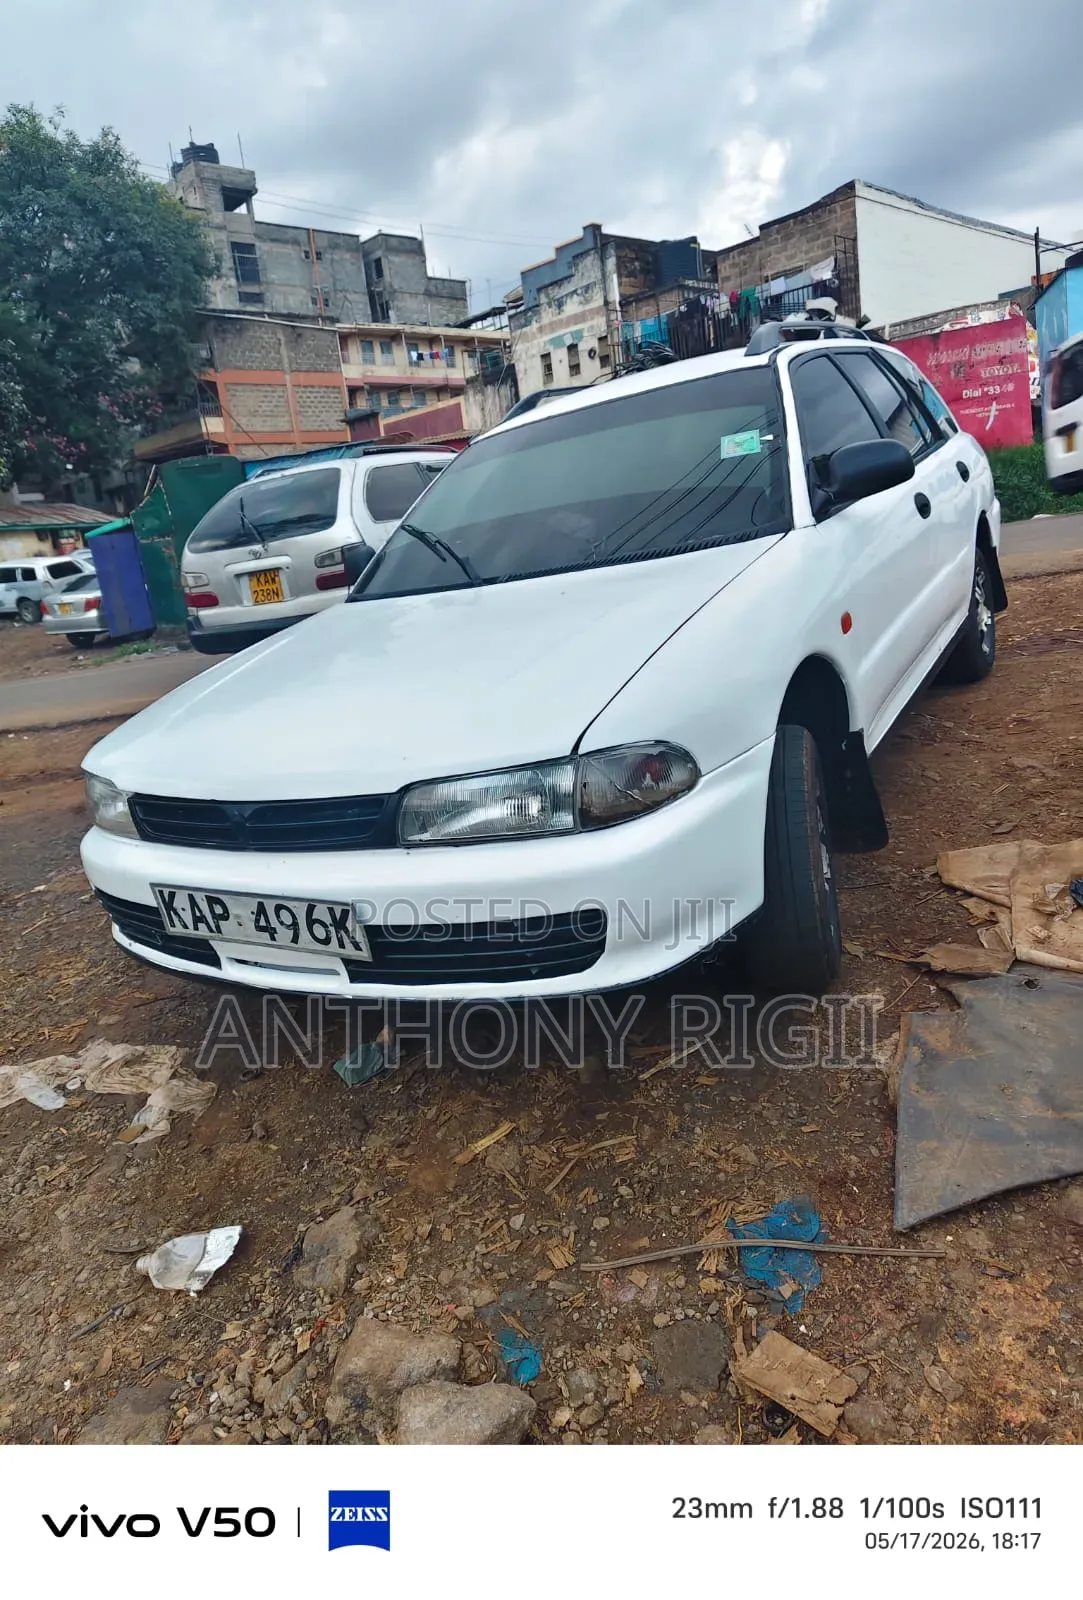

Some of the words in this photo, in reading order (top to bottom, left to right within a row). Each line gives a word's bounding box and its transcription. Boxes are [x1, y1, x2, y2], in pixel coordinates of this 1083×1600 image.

[962, 388, 982, 399] Dial
[255, 570, 280, 588] KAW
[253, 587, 280, 603] 238N
[157, 889, 230, 935] KAP
[253, 900, 364, 952] 496K
